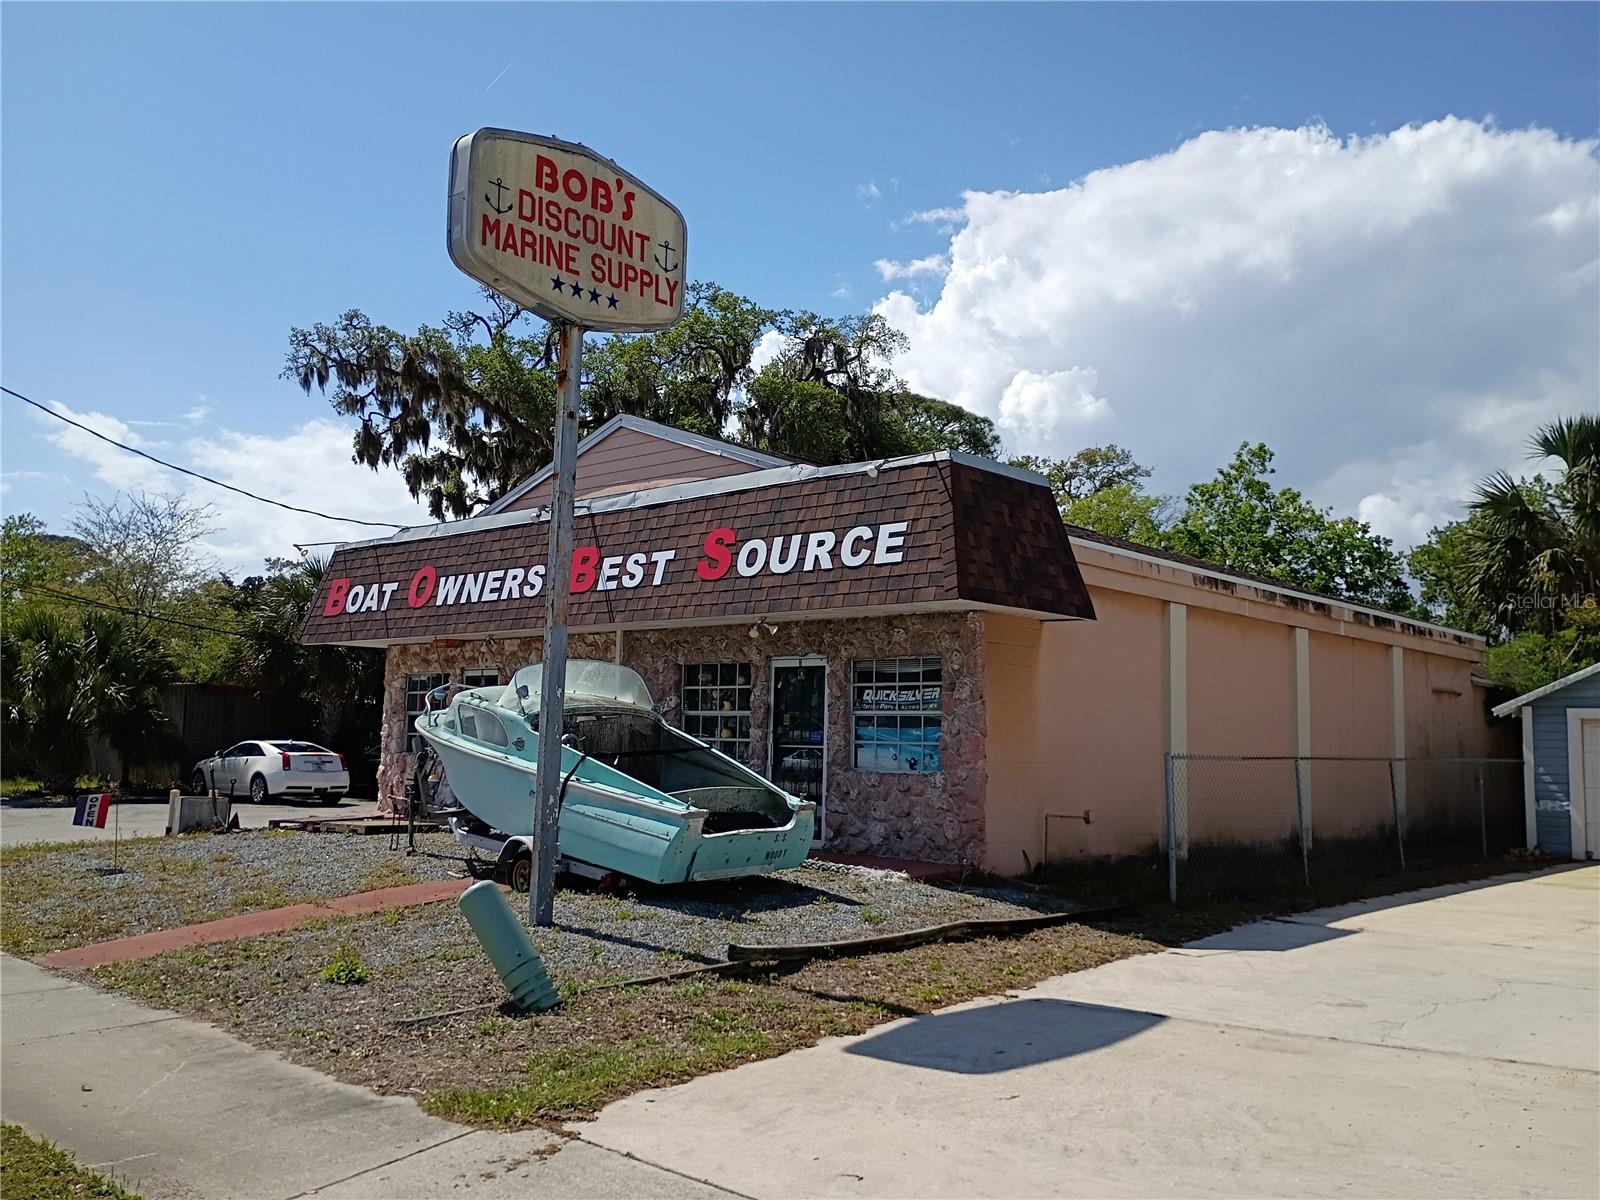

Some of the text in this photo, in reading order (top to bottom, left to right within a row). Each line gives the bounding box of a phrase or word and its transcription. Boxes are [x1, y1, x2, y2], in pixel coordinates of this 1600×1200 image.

[535, 154, 636, 221] BOB'S
[518, 188, 650, 262] DISCOUNT
[481, 214, 679, 307] MARINE SUPPLY
[323, 521, 909, 617] BOAT OWNERS BEST SOURCE
[862, 687, 940, 704] QUICKSILVER
[85, 796, 99, 827] OPEN
